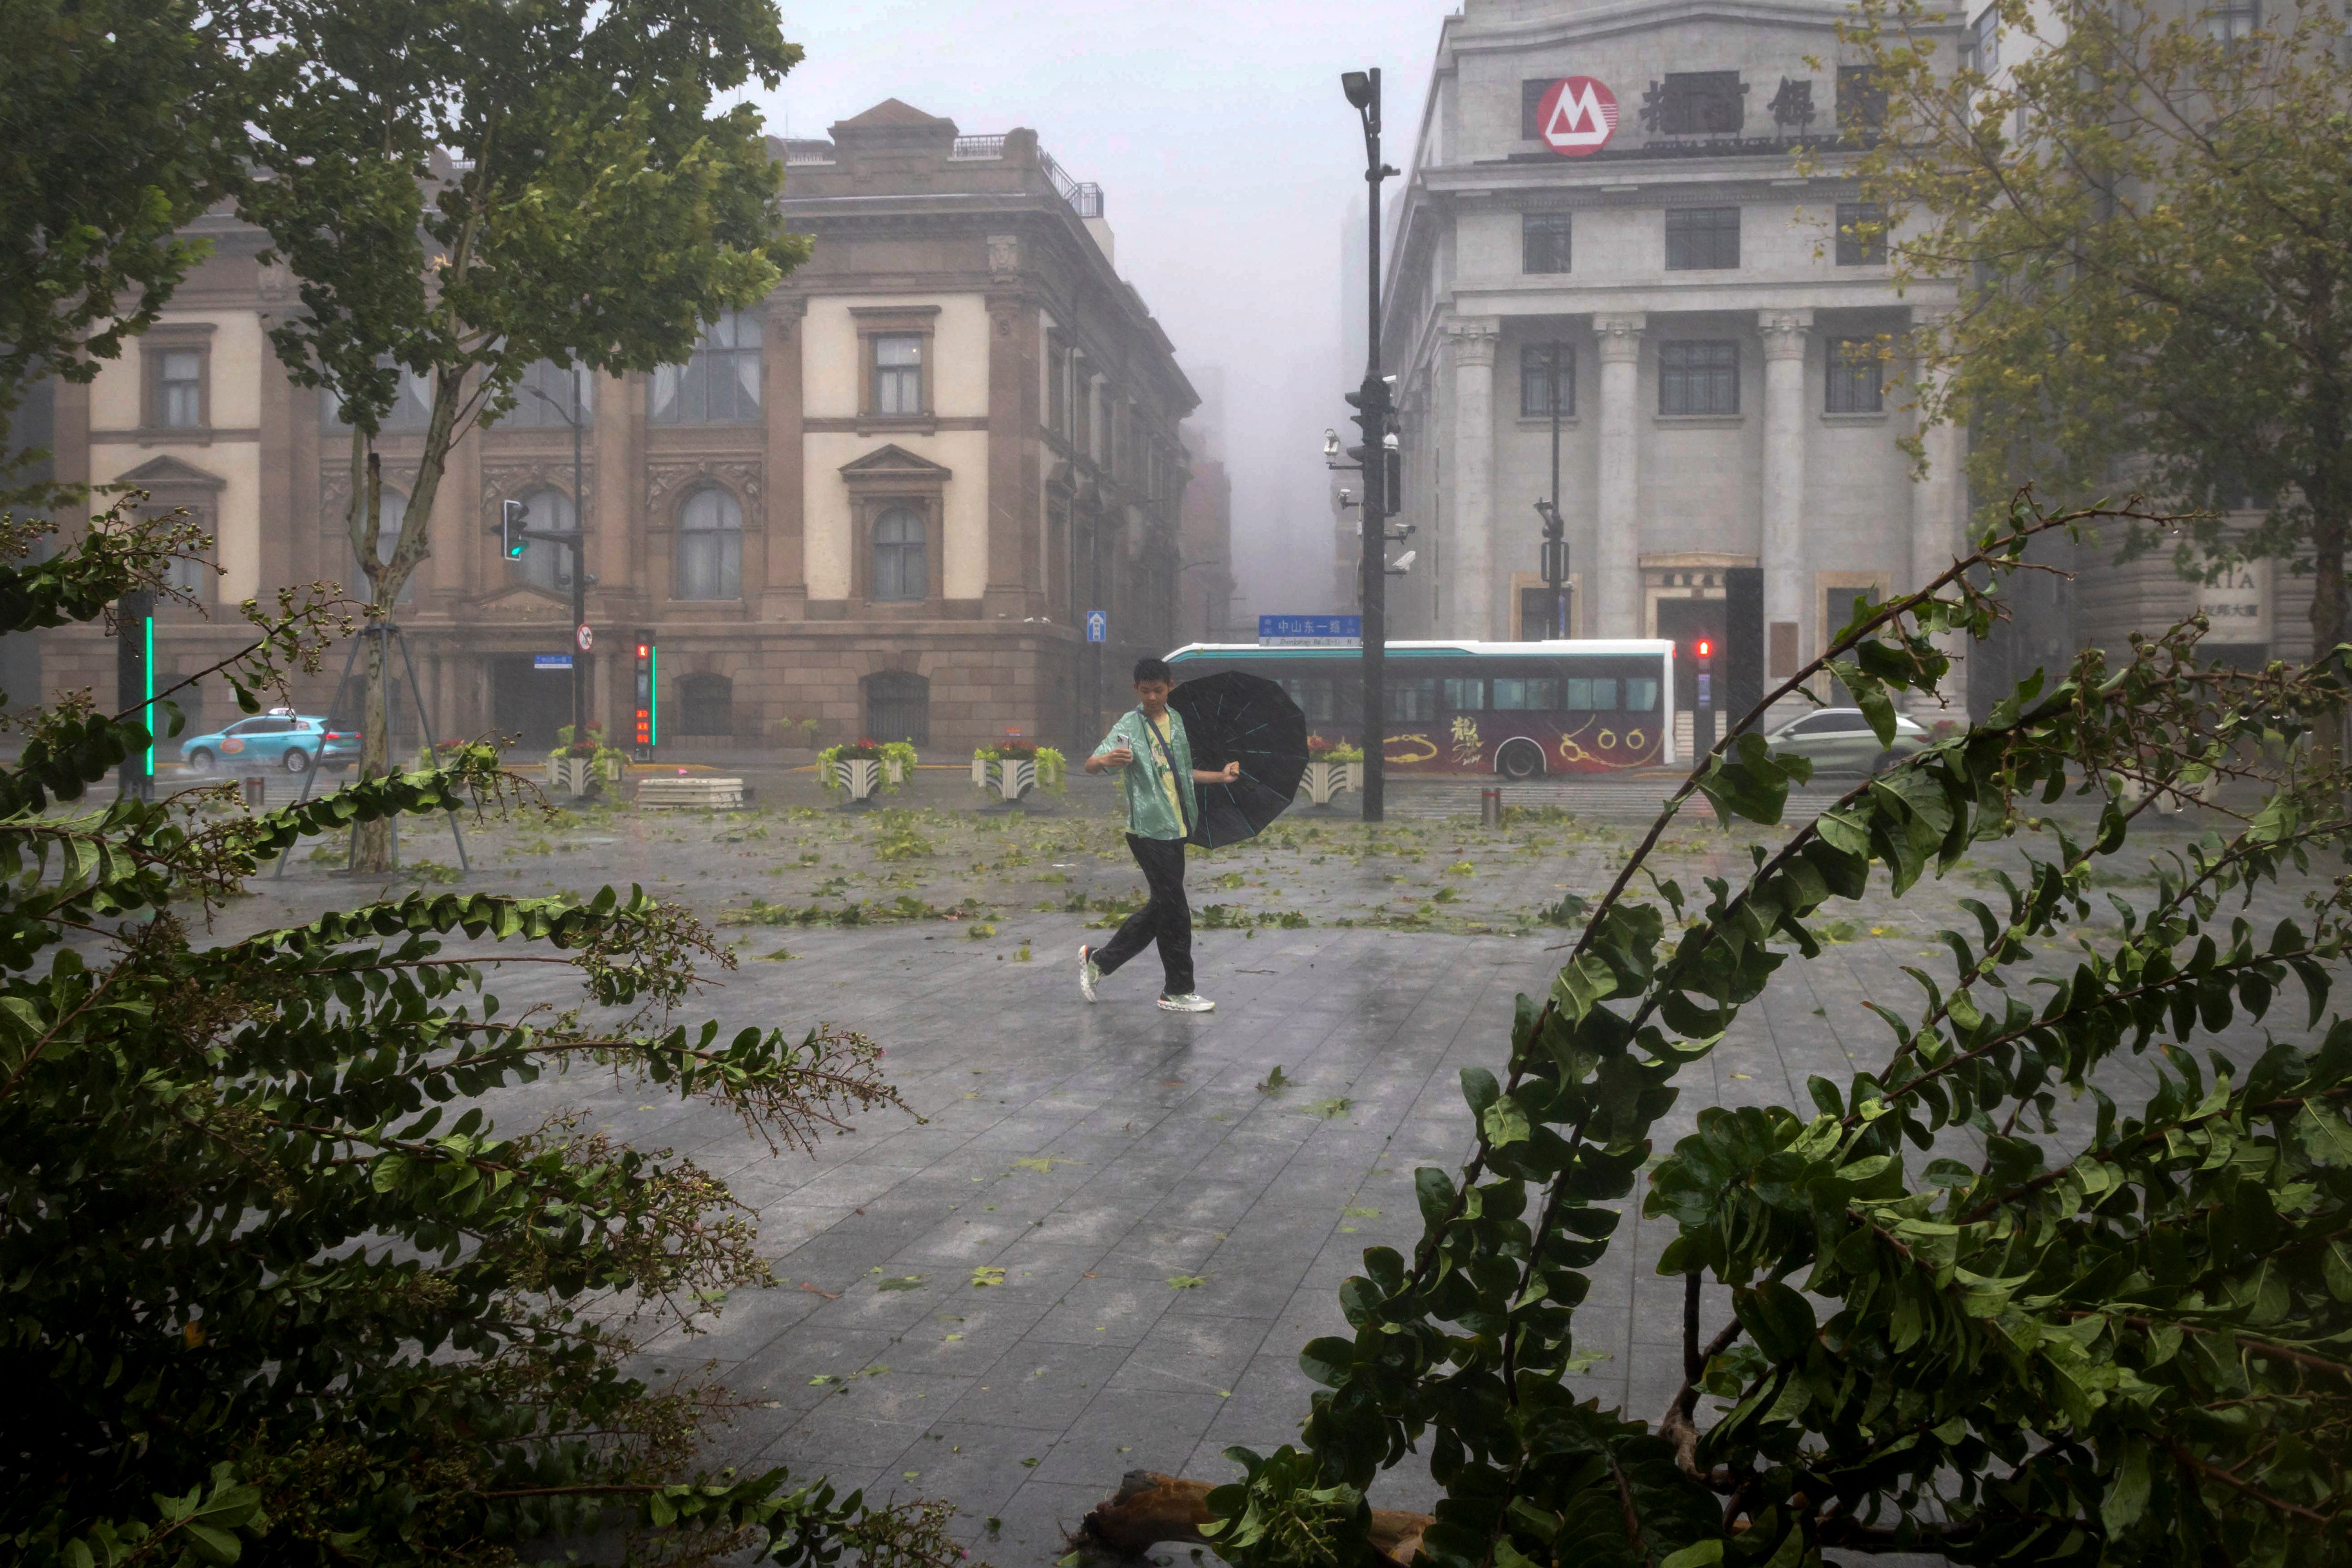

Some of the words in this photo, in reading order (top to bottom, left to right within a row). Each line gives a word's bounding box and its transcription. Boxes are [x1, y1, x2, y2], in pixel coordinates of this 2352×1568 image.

[1278, 619, 1340, 634] 中山东一路
